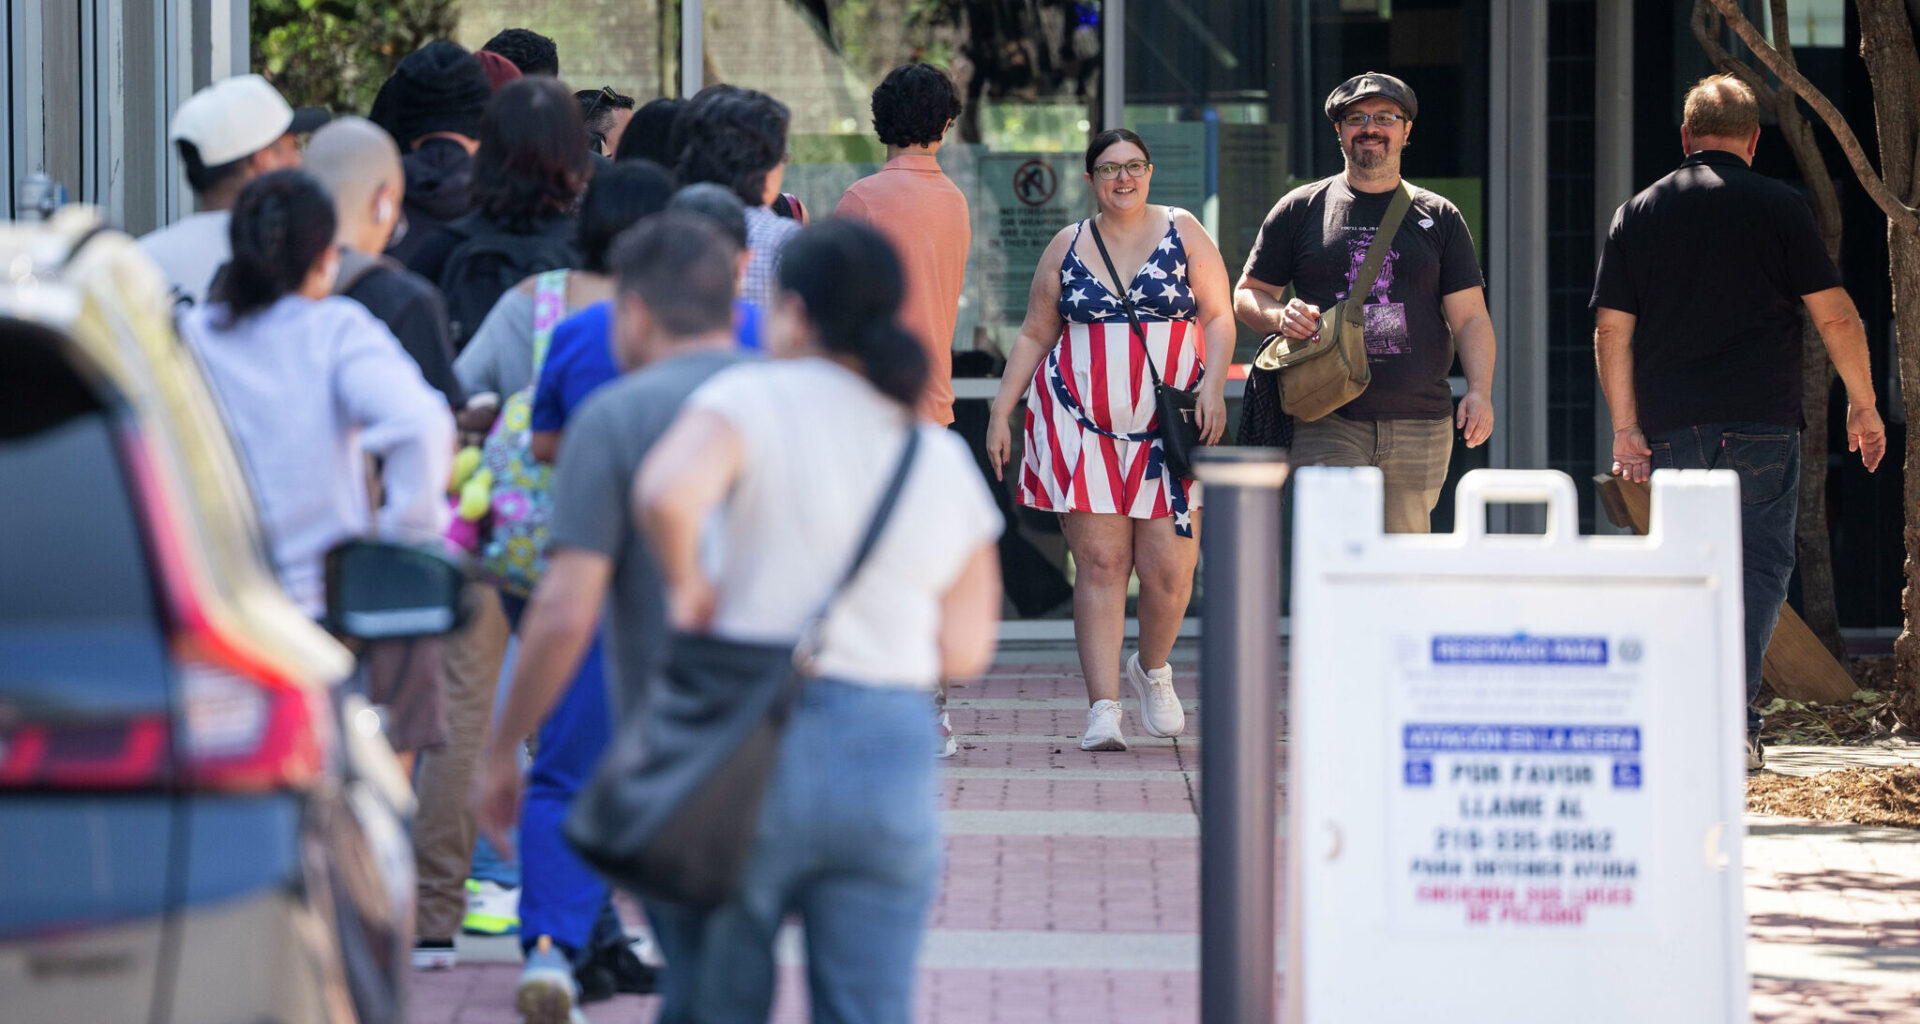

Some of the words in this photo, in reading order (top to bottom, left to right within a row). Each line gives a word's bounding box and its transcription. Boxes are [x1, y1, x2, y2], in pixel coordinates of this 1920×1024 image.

[1450, 763, 1502, 783] POR
[1512, 763, 1595, 784] FAVOR
[1459, 797, 1544, 818] LLAME
[1556, 798, 1586, 818] AL
